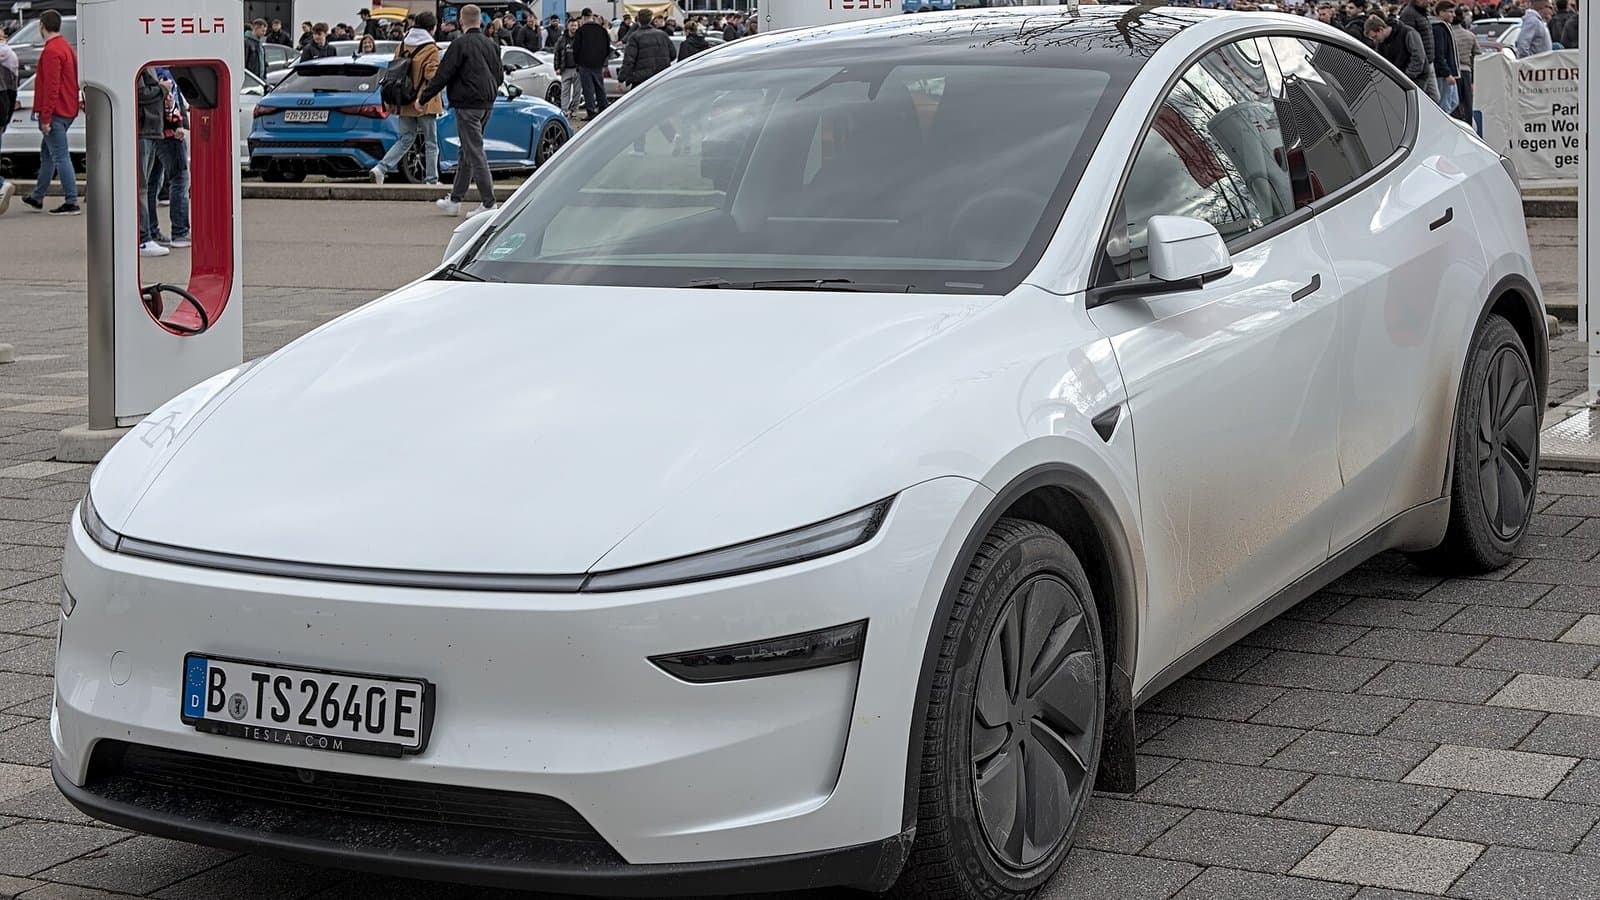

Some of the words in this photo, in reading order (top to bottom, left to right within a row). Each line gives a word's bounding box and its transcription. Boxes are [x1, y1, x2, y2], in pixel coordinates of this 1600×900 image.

[139, 18, 225, 34] TESLA
[1518, 68, 1579, 82] MOTOR
[1524, 122, 1546, 133] am
[207, 666, 227, 713] B
[191, 694, 200, 708] D
[243, 726, 343, 750] TESLA.COM
